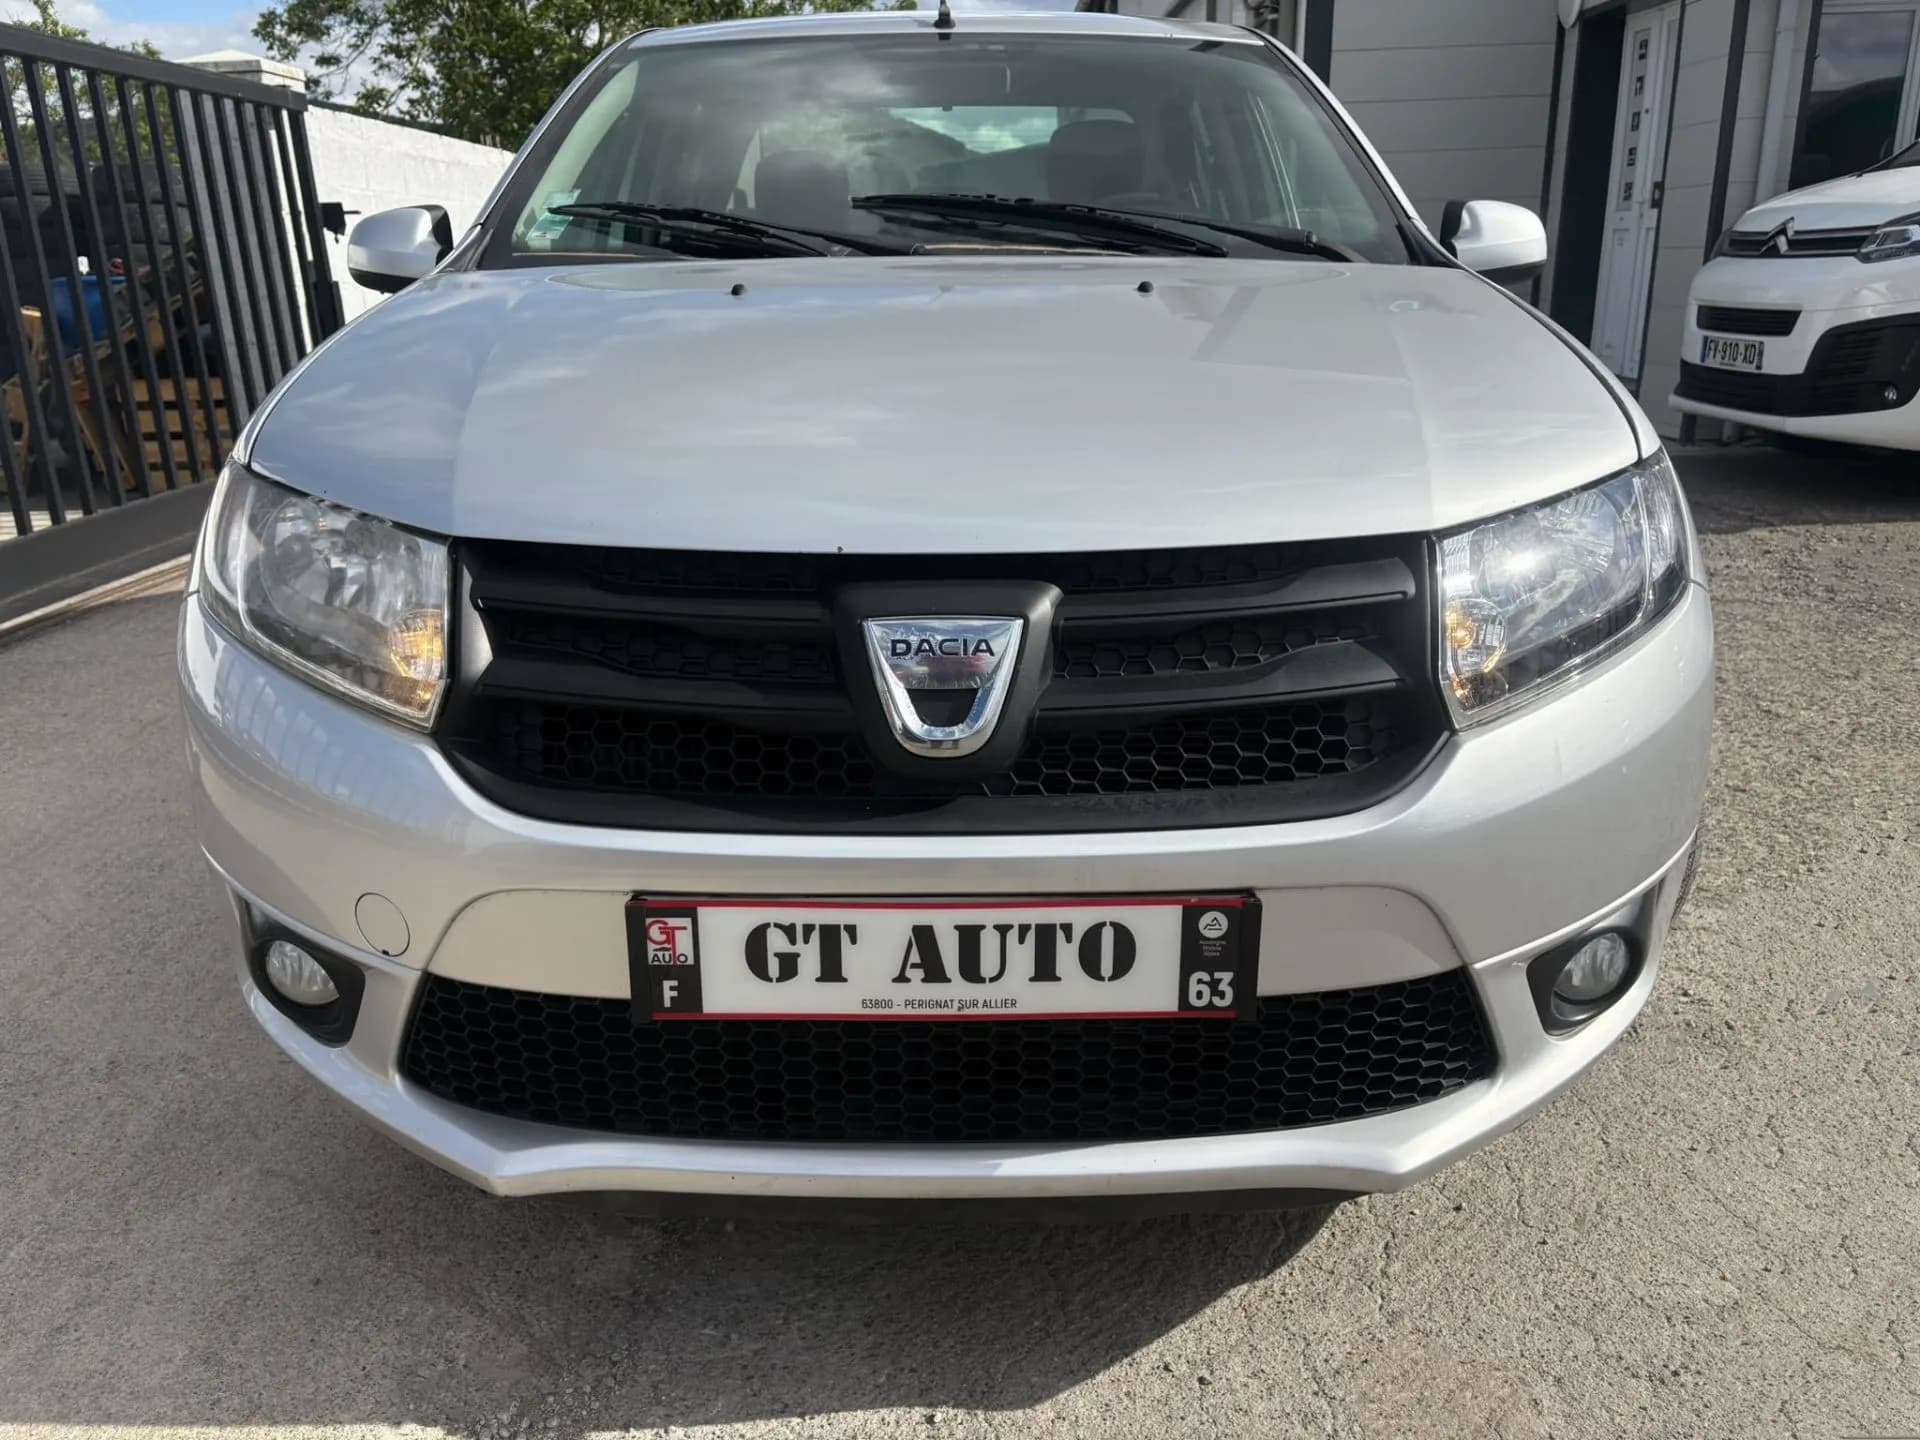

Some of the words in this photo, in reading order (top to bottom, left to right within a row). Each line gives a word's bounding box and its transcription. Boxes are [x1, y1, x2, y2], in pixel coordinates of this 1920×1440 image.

[890, 638, 995, 657] DACIA
[744, 921, 858, 983] GT
[891, 920, 1137, 984] AUTO
[662, 980, 679, 1008] F
[1188, 971, 1234, 1007] 63
[861, 998, 894, 1009] 63800
[904, 998, 954, 1009] PERIGNAT
[957, 998, 979, 1010] SUR
[982, 998, 1017, 1009] ALLIER
